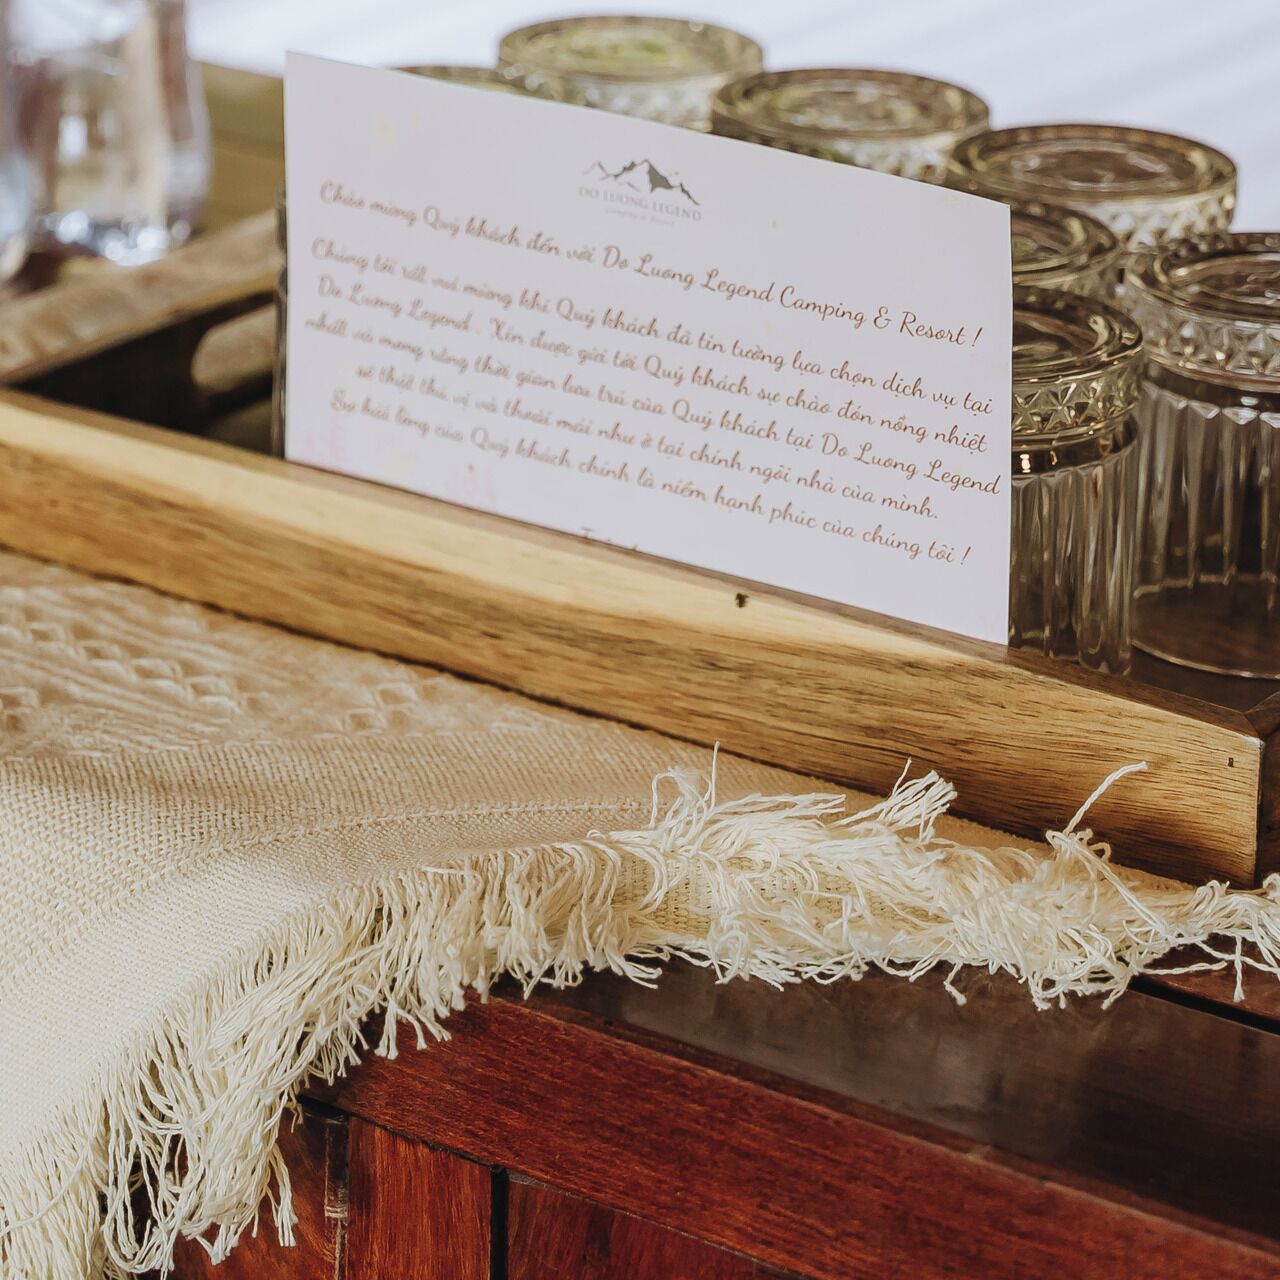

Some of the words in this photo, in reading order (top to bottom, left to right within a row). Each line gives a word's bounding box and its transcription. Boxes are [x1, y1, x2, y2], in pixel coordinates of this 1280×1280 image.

[374, 254, 397, 274] tôi
[556, 297, 595, 330] Quý
[601, 308, 660, 338] khách
[667, 323, 693, 346] đã
[698, 332, 725, 354] tin
[731, 339, 786, 371] tưởng
[792, 350, 824, 375] lựa
[830, 361, 877, 387] chọn
[882, 372, 927, 398] dịch
[932, 391, 958, 410] vụ
[963, 392, 993, 417] tại
[526, 232, 560, 256] đến
[602, 245, 630, 269] Do
[634, 253, 695, 291] Luong
[701, 269, 775, 303] Legend
[780, 285, 867, 328] Camping
[873, 306, 892, 328] &
[900, 311, 966, 346] Resort
[490, 317, 525, 343] Xin
[644, 354, 684, 387] Quý
[691, 365, 752, 396] khách
[757, 388, 780, 406] sự
[786, 389, 832, 414] chào
[838, 400, 874, 425] đón
[880, 416, 929, 443] nồng
[935, 425, 988, 454] nhiệt
[598, 422, 636, 445] như
[657, 436, 684, 460] tại
[689, 442, 745, 471] chính
[749, 462, 791, 484] ngôi
[796, 469, 836, 494] nhà
[841, 485, 876, 504] của
[881, 494, 938, 519] mình.
[632, 398, 665, 415] của
[672, 398, 713, 431] Quý
[720, 410, 780, 441] khách
[786, 428, 814, 451] tại
[822, 432, 848, 457] Do
[856, 442, 918, 480] Luong
[923, 459, 1001, 495] Legend
[578, 455, 631, 483] chính
[637, 467, 656, 490] là
[714, 484, 764, 516] hạnh
[769, 502, 817, 529] phúc
[822, 520, 857, 538] của
[862, 524, 923, 560] chúng
[928, 540, 956, 563] tôi
